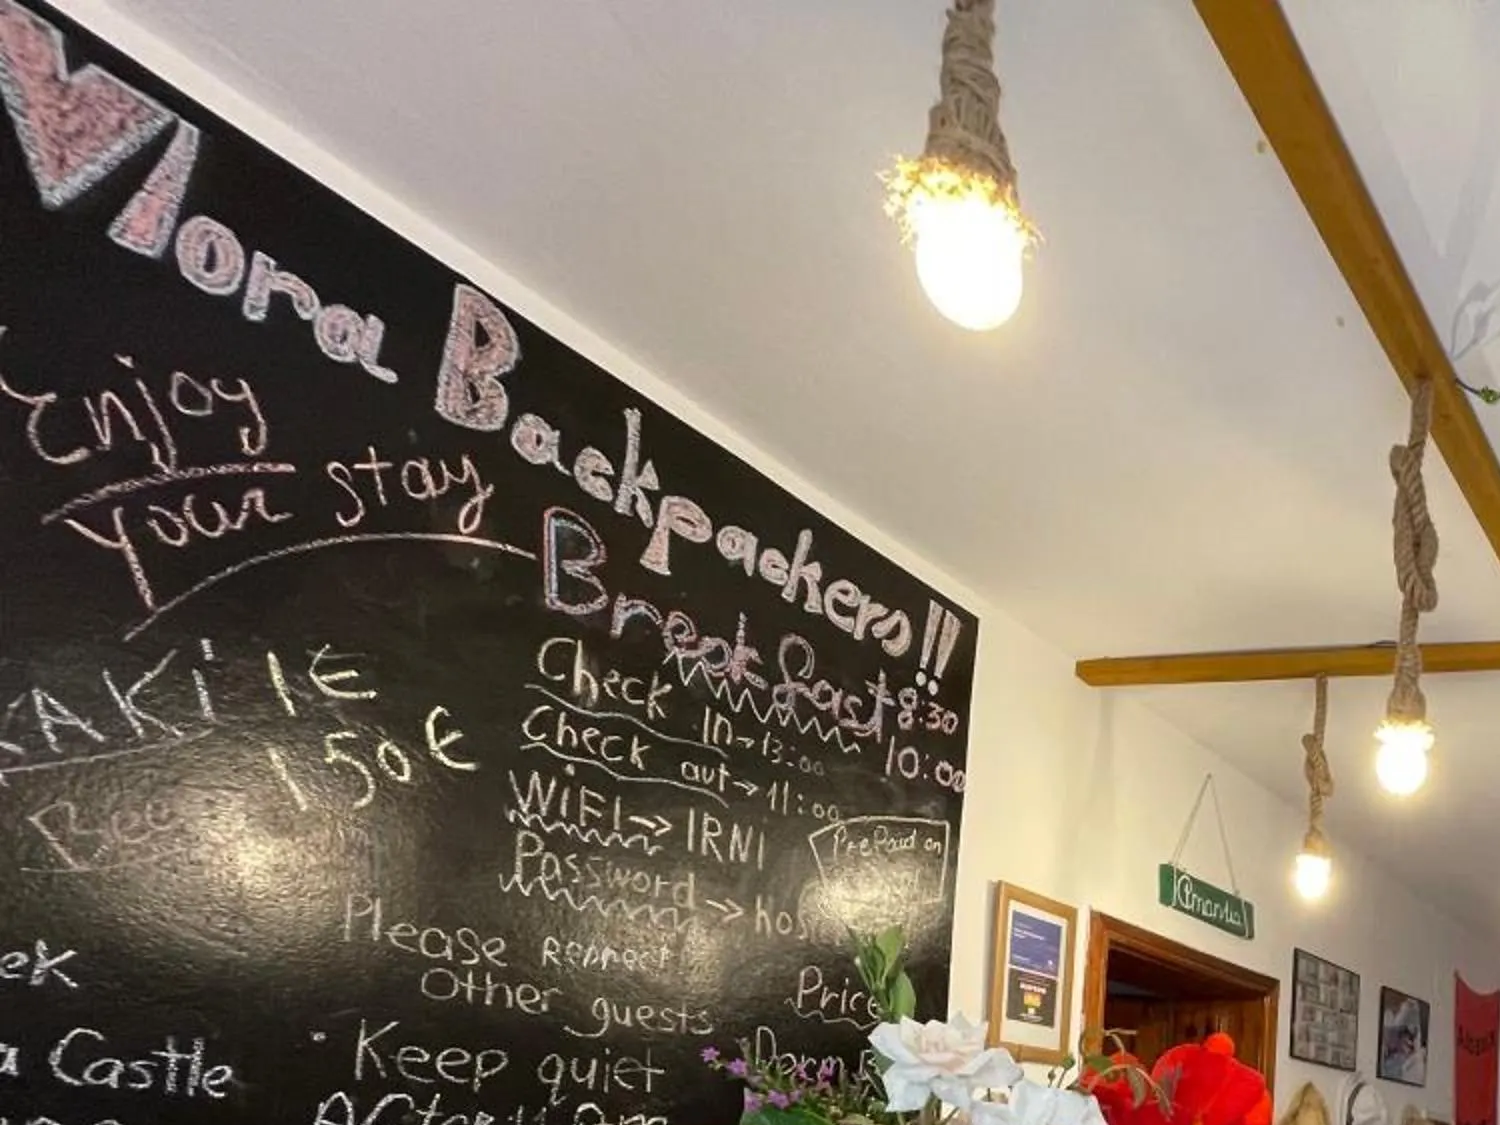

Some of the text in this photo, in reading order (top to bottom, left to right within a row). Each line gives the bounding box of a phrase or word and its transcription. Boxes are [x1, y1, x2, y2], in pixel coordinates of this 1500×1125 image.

[0, 324, 268, 476] Enjoy
[536, 636, 673, 720] Check
[345, 894, 509, 968] Please
[562, 997, 714, 1038] guests
[49, 1027, 234, 1098] Castle
[355, 1018, 666, 1106] Keep quiet
